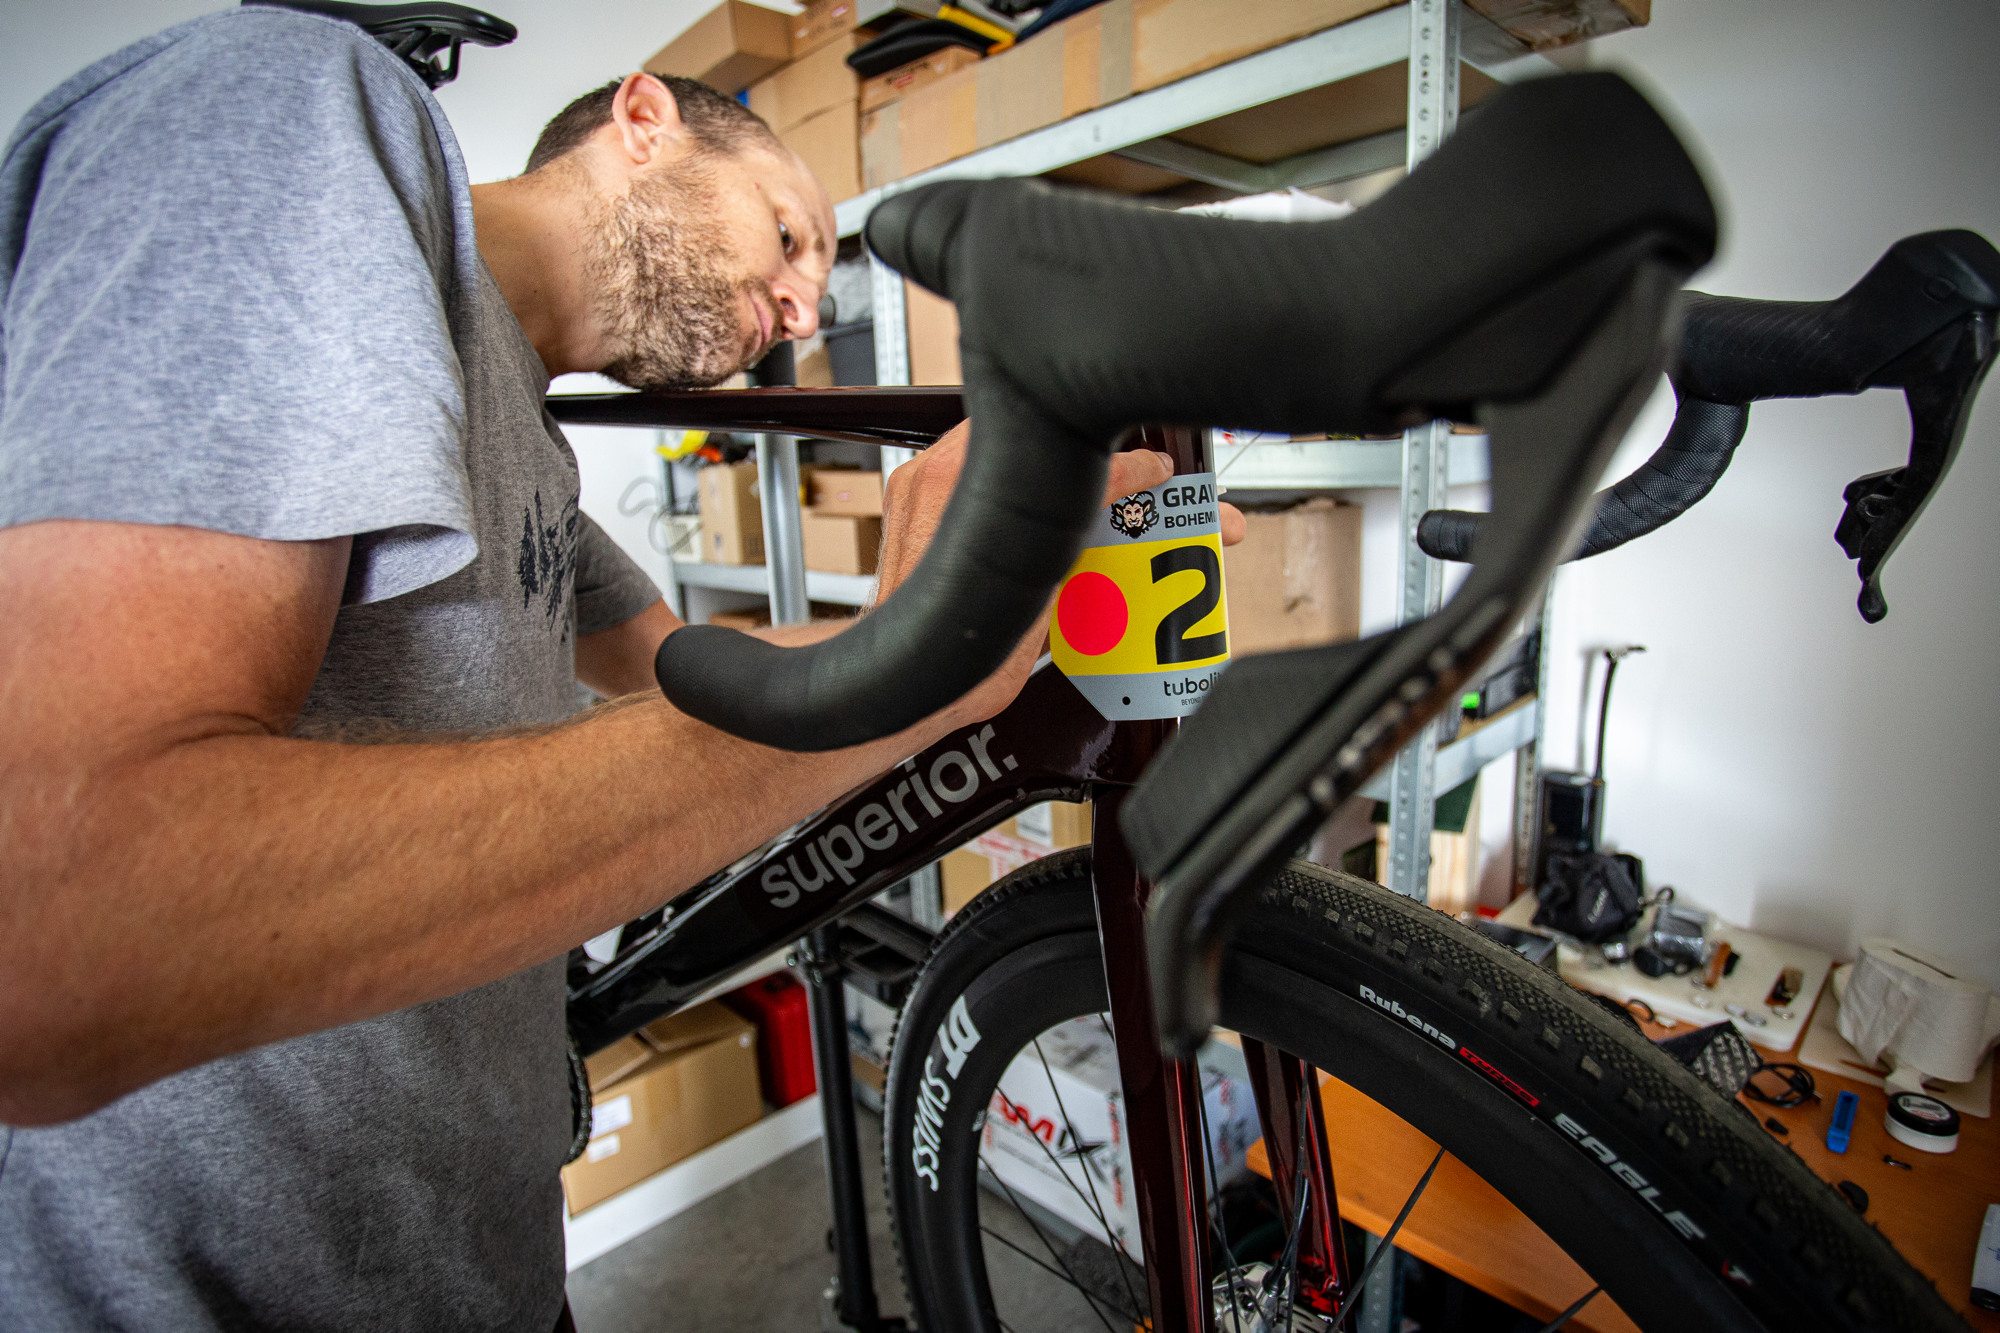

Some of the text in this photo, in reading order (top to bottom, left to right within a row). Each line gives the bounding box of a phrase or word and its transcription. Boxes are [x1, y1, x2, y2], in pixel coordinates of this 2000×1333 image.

[1150, 545, 1228, 666] 2
[1163, 671, 1220, 696] tuboli
[760, 723, 1019, 909] superior.
[912, 994, 982, 1192] DT SWISS
[1359, 984, 1706, 1240] Rubena TYRES EAGLE
